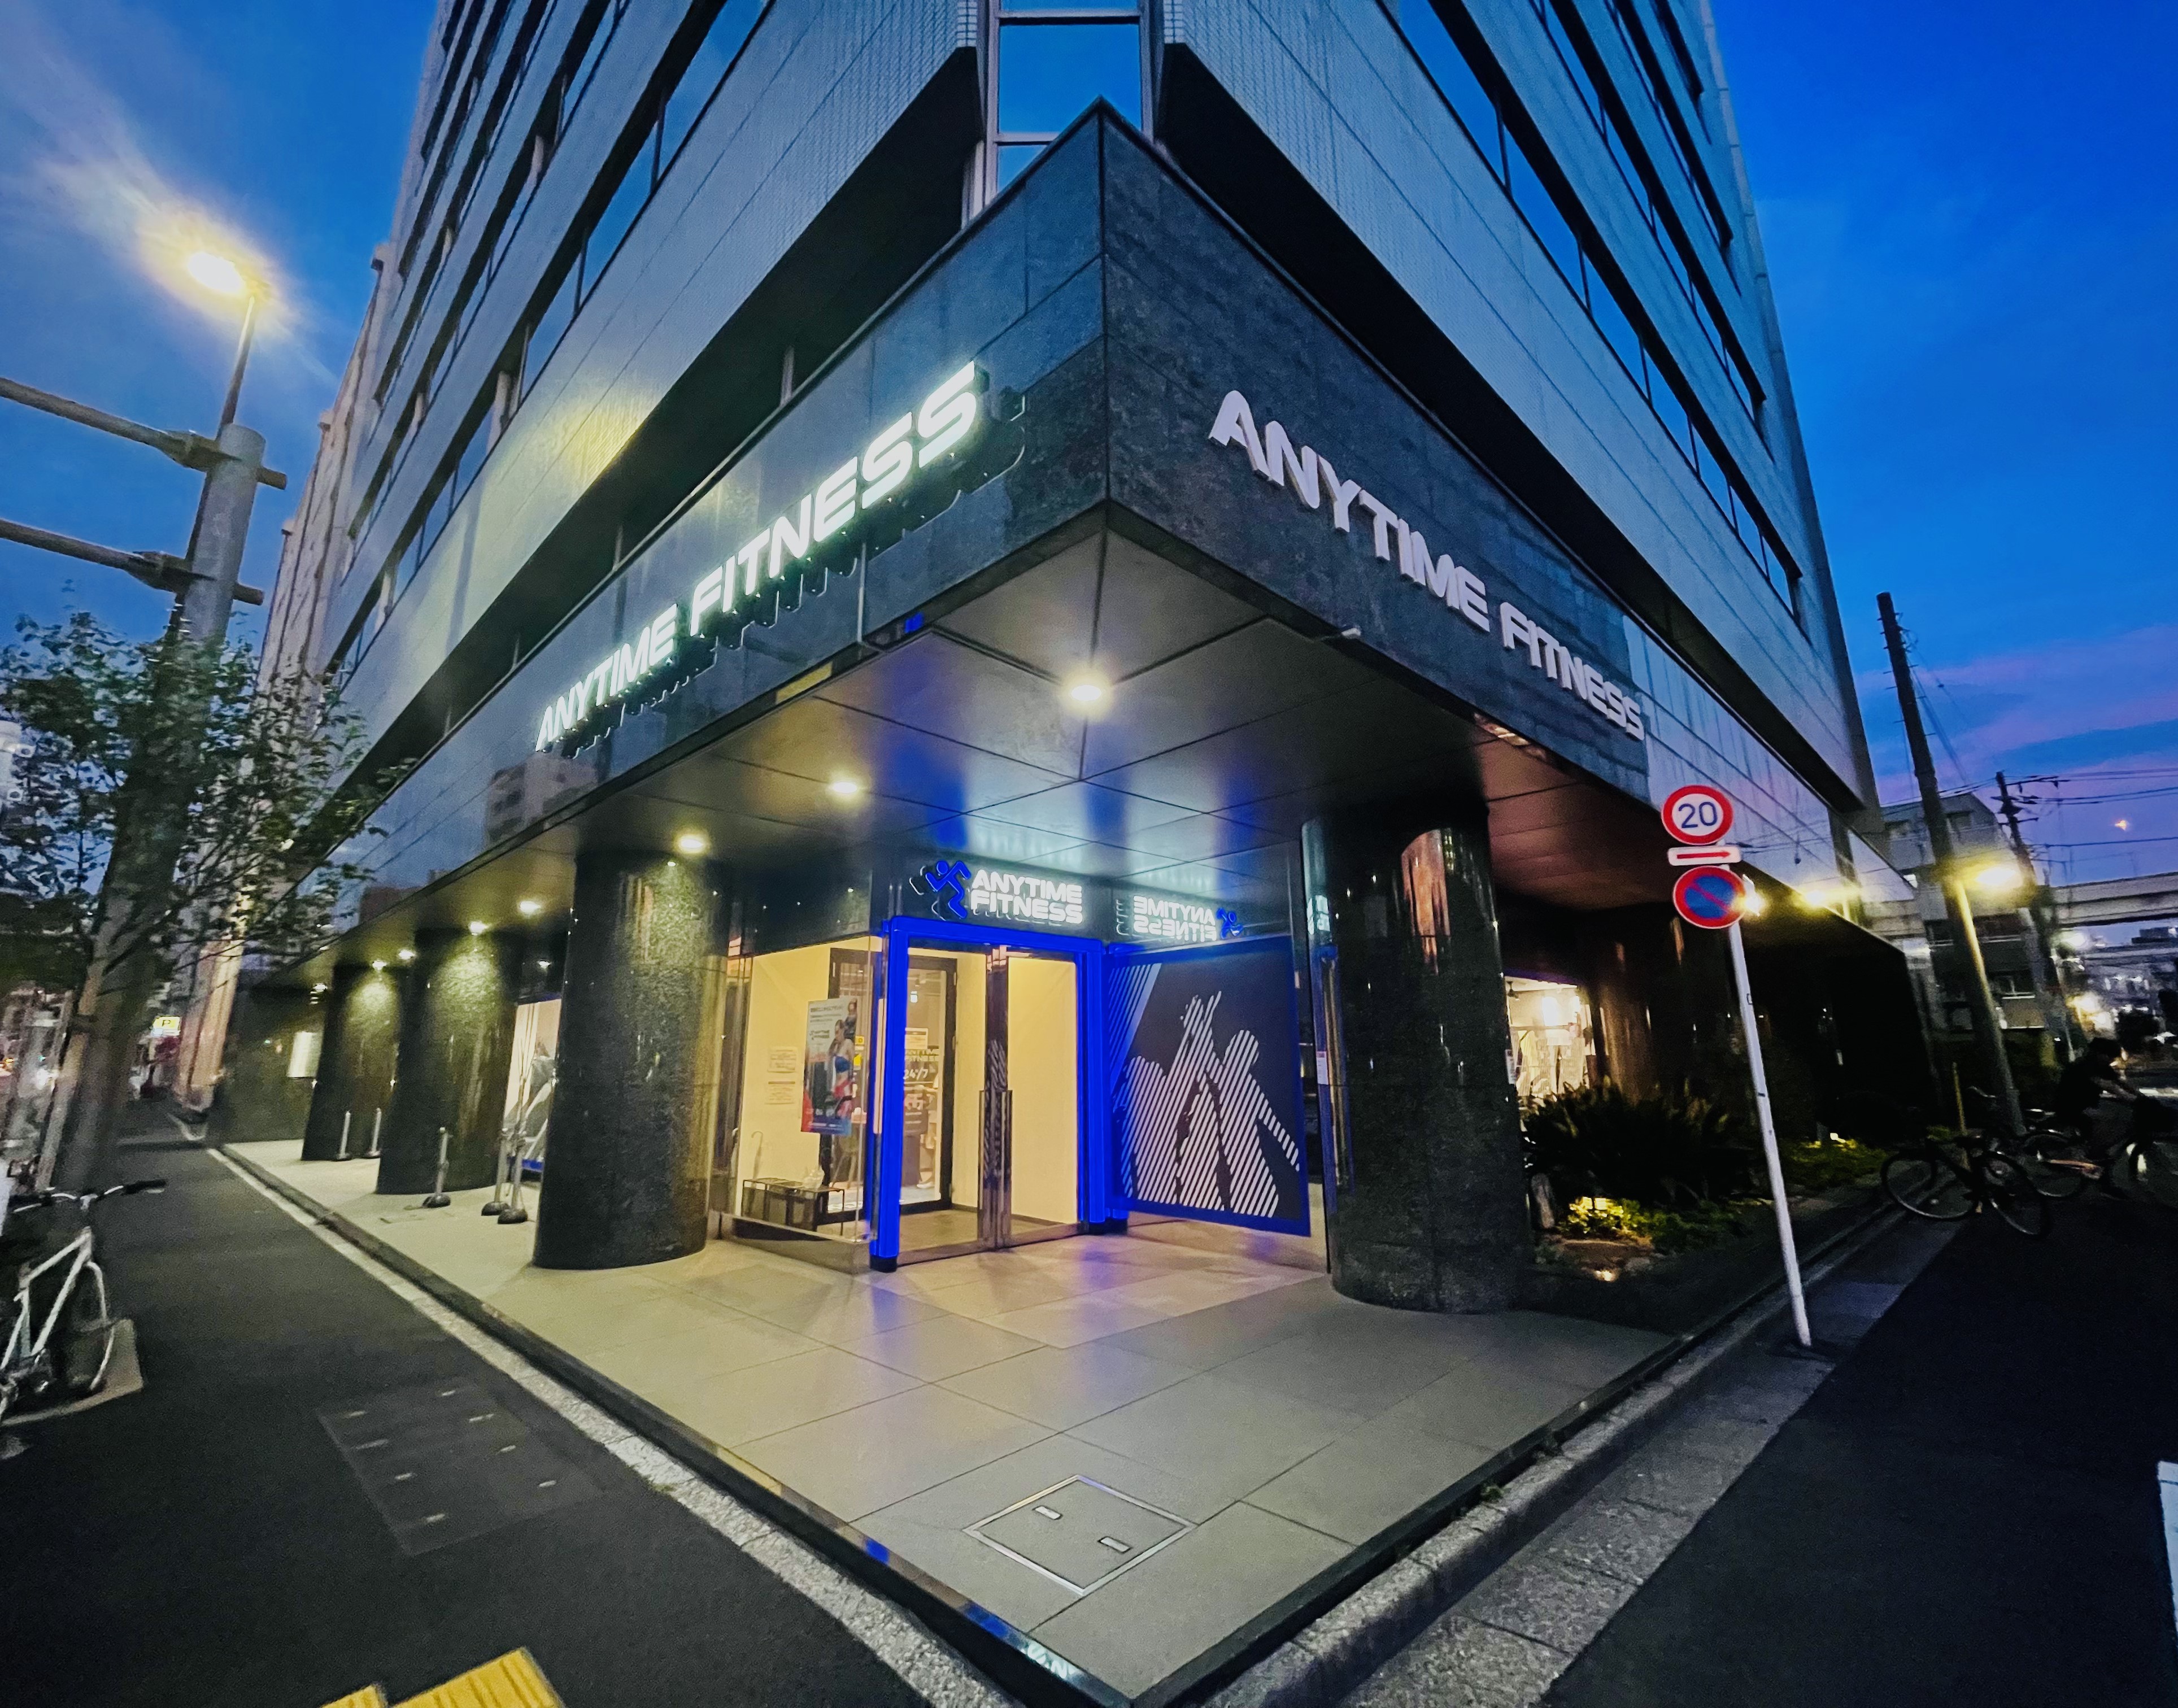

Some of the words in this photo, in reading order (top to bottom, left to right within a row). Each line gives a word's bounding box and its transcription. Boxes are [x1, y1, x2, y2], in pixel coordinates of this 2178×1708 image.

[535, 604, 678, 752] ANYTIME
[690, 361, 976, 637] FITNESS
[1208, 390, 1490, 633] ANYTIME
[1500, 602, 1644, 741] FITNESS
[1678, 801, 1718, 829] 20
[972, 869, 1082, 904] ANYTIME
[971, 889, 1083, 924] FITNESS
